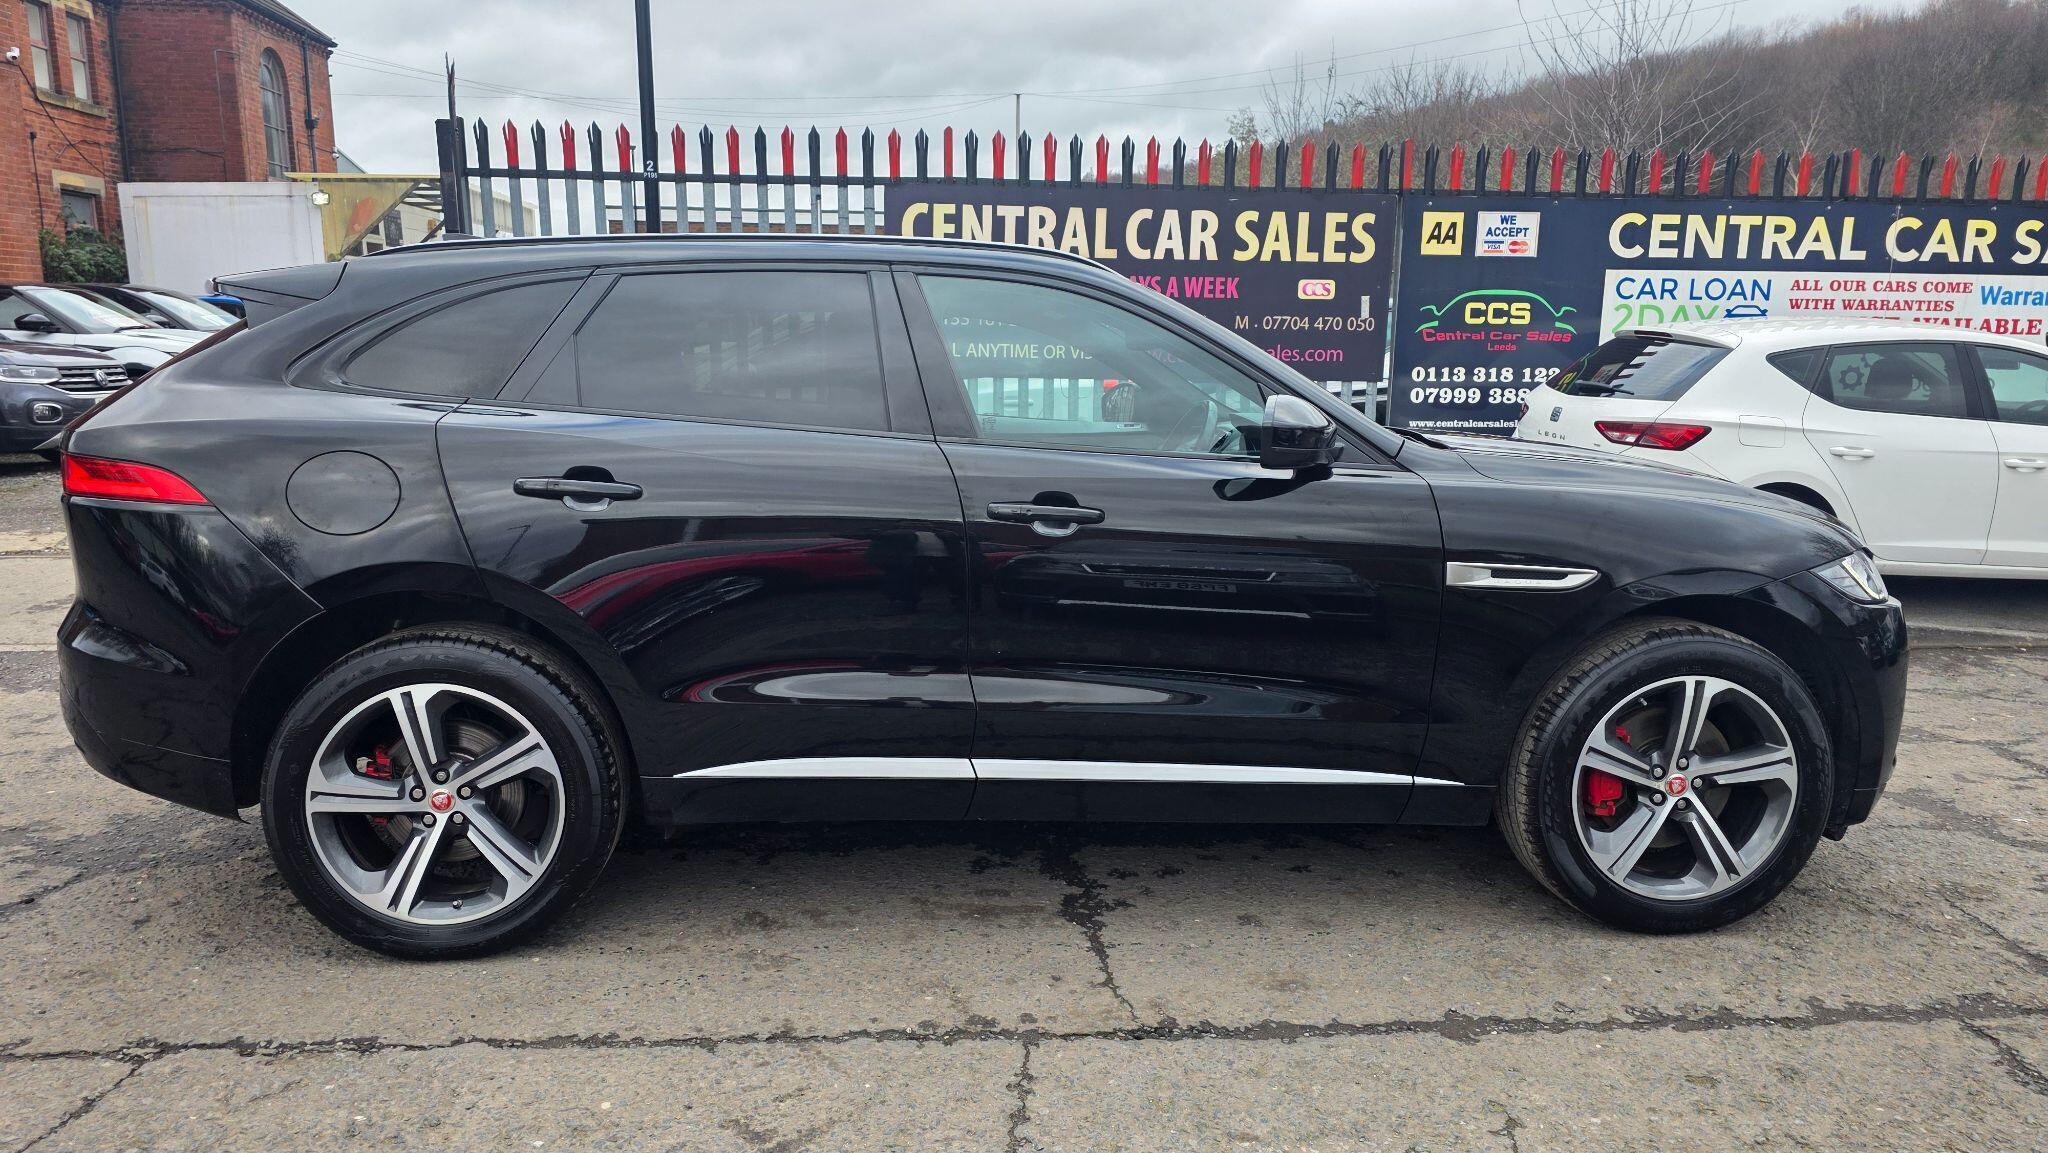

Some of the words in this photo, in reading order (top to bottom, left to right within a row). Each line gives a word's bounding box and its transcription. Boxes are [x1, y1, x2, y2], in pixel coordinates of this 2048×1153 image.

[646, 161, 654, 171] 2
[1500, 214, 1517, 226] WE
[902, 202, 1118, 259] CENTRAL
[1125, 208, 1220, 260] CAR
[1233, 211, 1376, 263] SALES
[1425, 221, 1458, 245] AA
[1486, 226, 1530, 238] ACCEPT
[1608, 212, 1868, 261] CENTRAL
[1885, 217, 1997, 263] CAR
[1166, 276, 1179, 298] A
[1184, 276, 1240, 299] WEEK
[1615, 277, 1679, 300] CAR
[1689, 278, 1772, 301] LOAN
[1790, 279, 1828, 291] ALL
[1829, 280, 1866, 292] OUR
[1873, 280, 1917, 293] CARS
[1923, 281, 1974, 294] COME
[1980, 285, 2048, 306] Warra
[1789, 298, 1835, 310] WITH
[1842, 299, 1955, 312] WARRANTIES
[1464, 302, 1531, 325] CCS
[1235, 315, 1249, 330] M
[1263, 316, 1309, 331] 07704
[1314, 317, 1343, 331] 470
[1347, 317, 1375, 331] 050
[1422, 328, 1485, 342] Central
[1489, 330, 1522, 341] Car
[1526, 331, 1573, 343] Sales
[966, 343, 1038, 359] ANYTIME
[1043, 345, 1065, 359] OR
[1487, 342, 1517, 351] Leeds
[1411, 366, 1466, 383] 0113
[1473, 366, 1514, 383] 318
[1410, 387, 1482, 404] 07999
[1537, 429, 1566, 441] LEON
